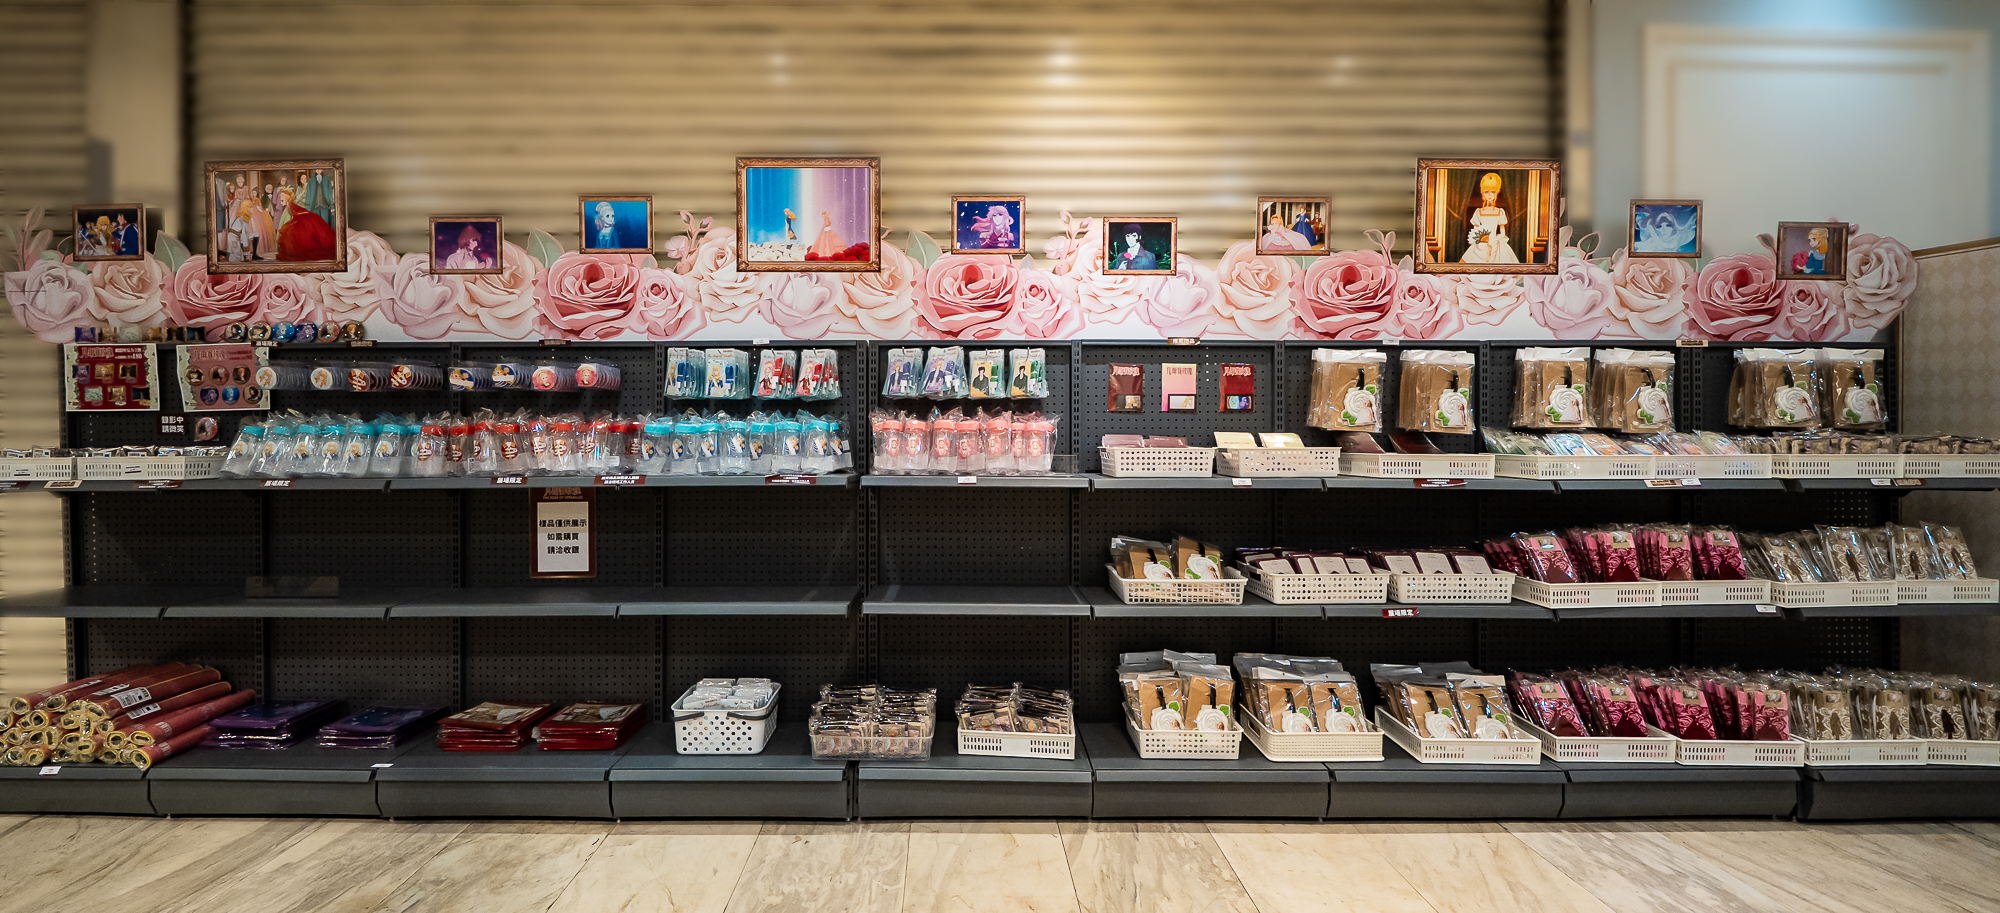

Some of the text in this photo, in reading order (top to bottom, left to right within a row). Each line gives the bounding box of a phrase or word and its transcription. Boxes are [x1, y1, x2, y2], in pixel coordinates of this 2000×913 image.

[539, 519, 587, 528] 樣品僅供展示
[547, 532, 579, 541] 如需購買
[547, 545, 580, 554] 請洽收銀
